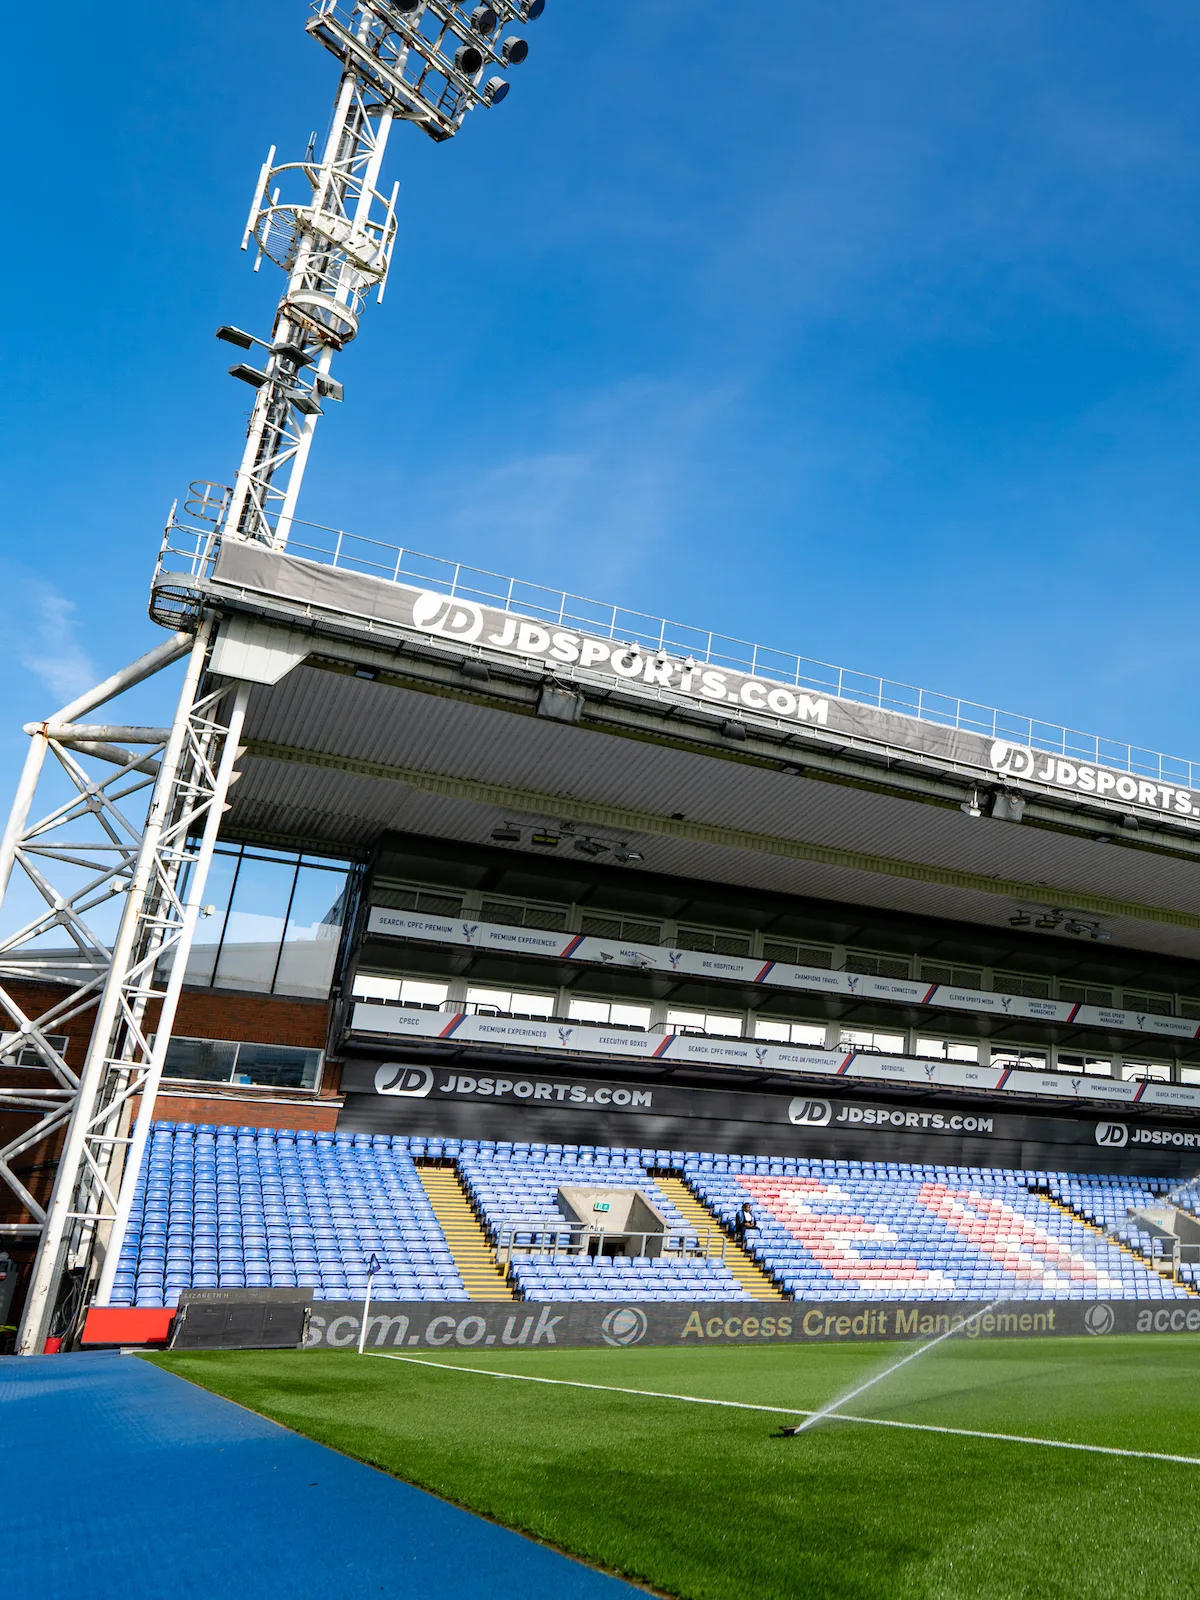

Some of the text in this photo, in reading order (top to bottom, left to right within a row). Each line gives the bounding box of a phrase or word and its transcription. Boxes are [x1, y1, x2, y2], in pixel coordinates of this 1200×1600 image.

[487, 618, 829, 725] JDSPORTS.COM
[407, 921, 423, 929] CPFC
[424, 924, 453, 933] PREMIUM
[489, 932, 556, 947] PREMIUM EXPERIENCES
[713, 962, 744, 973] HOSPITALITY
[794, 973, 839, 985] CHAMPIONS TRAVEL
[874, 984, 918, 995] TRAVEL CONNECTION
[949, 994, 994, 1005] ELEVEN SPORTS MEDIA
[399, 1016, 420, 1026] CPSCC
[478, 1025, 547, 1038] PREMIUM EXPERIENCES
[599, 1037, 648, 1048] EXECUTIVE BOXES
[710, 1047, 723, 1055] CPFC
[724, 1049, 748, 1058] PREMIUM
[778, 1055, 837, 1066] CPFC.CO.UK/HOSPITALITY
[439, 1075, 653, 1108] JDSPORTS.COM
[835, 1105, 994, 1134] JDSPORTS.COM
[681, 1308, 1056, 1339] Access Credit Management
